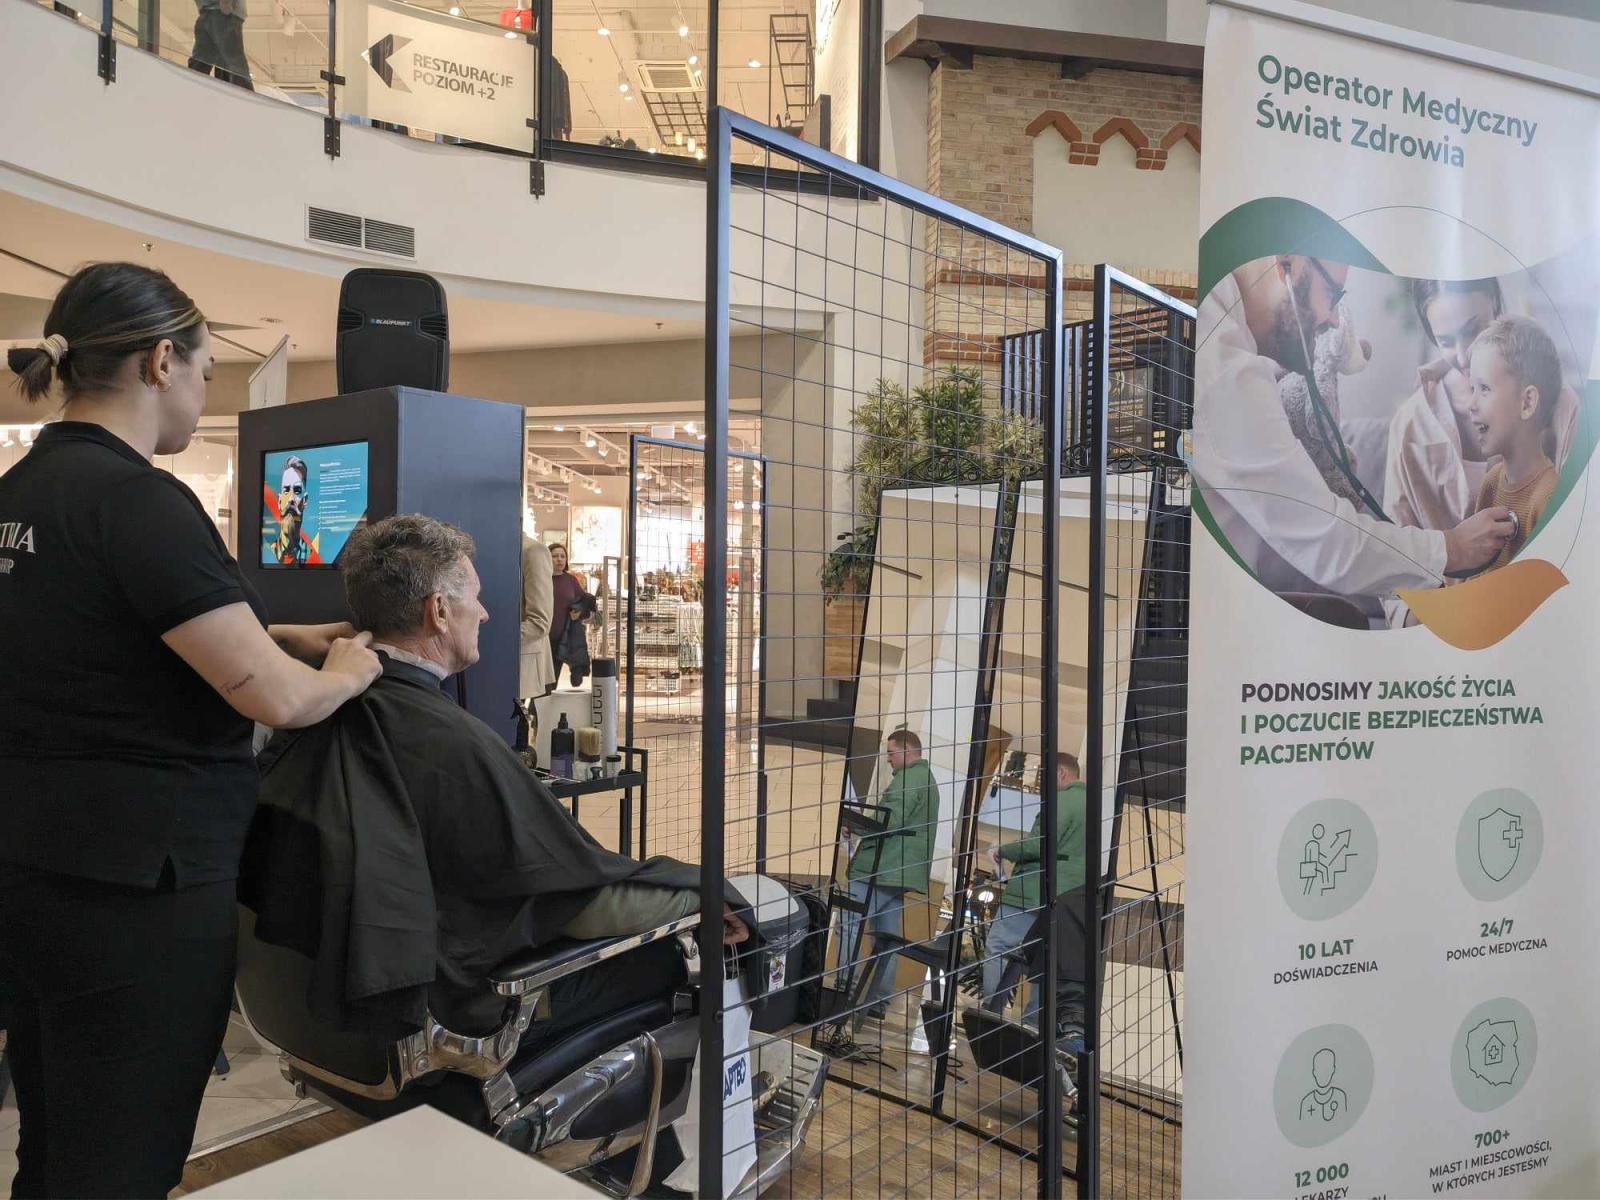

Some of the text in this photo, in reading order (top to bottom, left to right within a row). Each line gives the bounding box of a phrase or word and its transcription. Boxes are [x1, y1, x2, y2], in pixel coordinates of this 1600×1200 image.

[413, 53, 514, 89] RESTAURACJE
[413, 69, 496, 101] POZIOM +2
[1257, 54, 1538, 147] Operator Medyczny
[1256, 92, 1465, 168] Świat Zdrowia
[1241, 674, 1516, 703] PODNOSIMY JAKOŚĆ ŻYCIA
[1241, 703, 1544, 734] I POCZUCIE BEZPIECZEŃSTWA
[1240, 737, 1374, 765] PACJENTÓW
[1480, 918, 1514, 938] 24/7
[1298, 939, 1354, 961] 10 LAT
[1446, 938, 1548, 962] POMOC MEDYCZNA
[1273, 960, 1379, 985] DOŚWIADCZENIA
[1474, 1129, 1510, 1149] 700+
[1429, 1160, 1462, 1178] MIAST
[1471, 1140, 1552, 1168] MIEJSCOWOŚCI,
[1295, 1162, 1349, 1188] 12 000
[1432, 1156, 1549, 1194] W KTÓRYCH JESTEŚMY
[1295, 1186, 1349, 1200] KARZY
